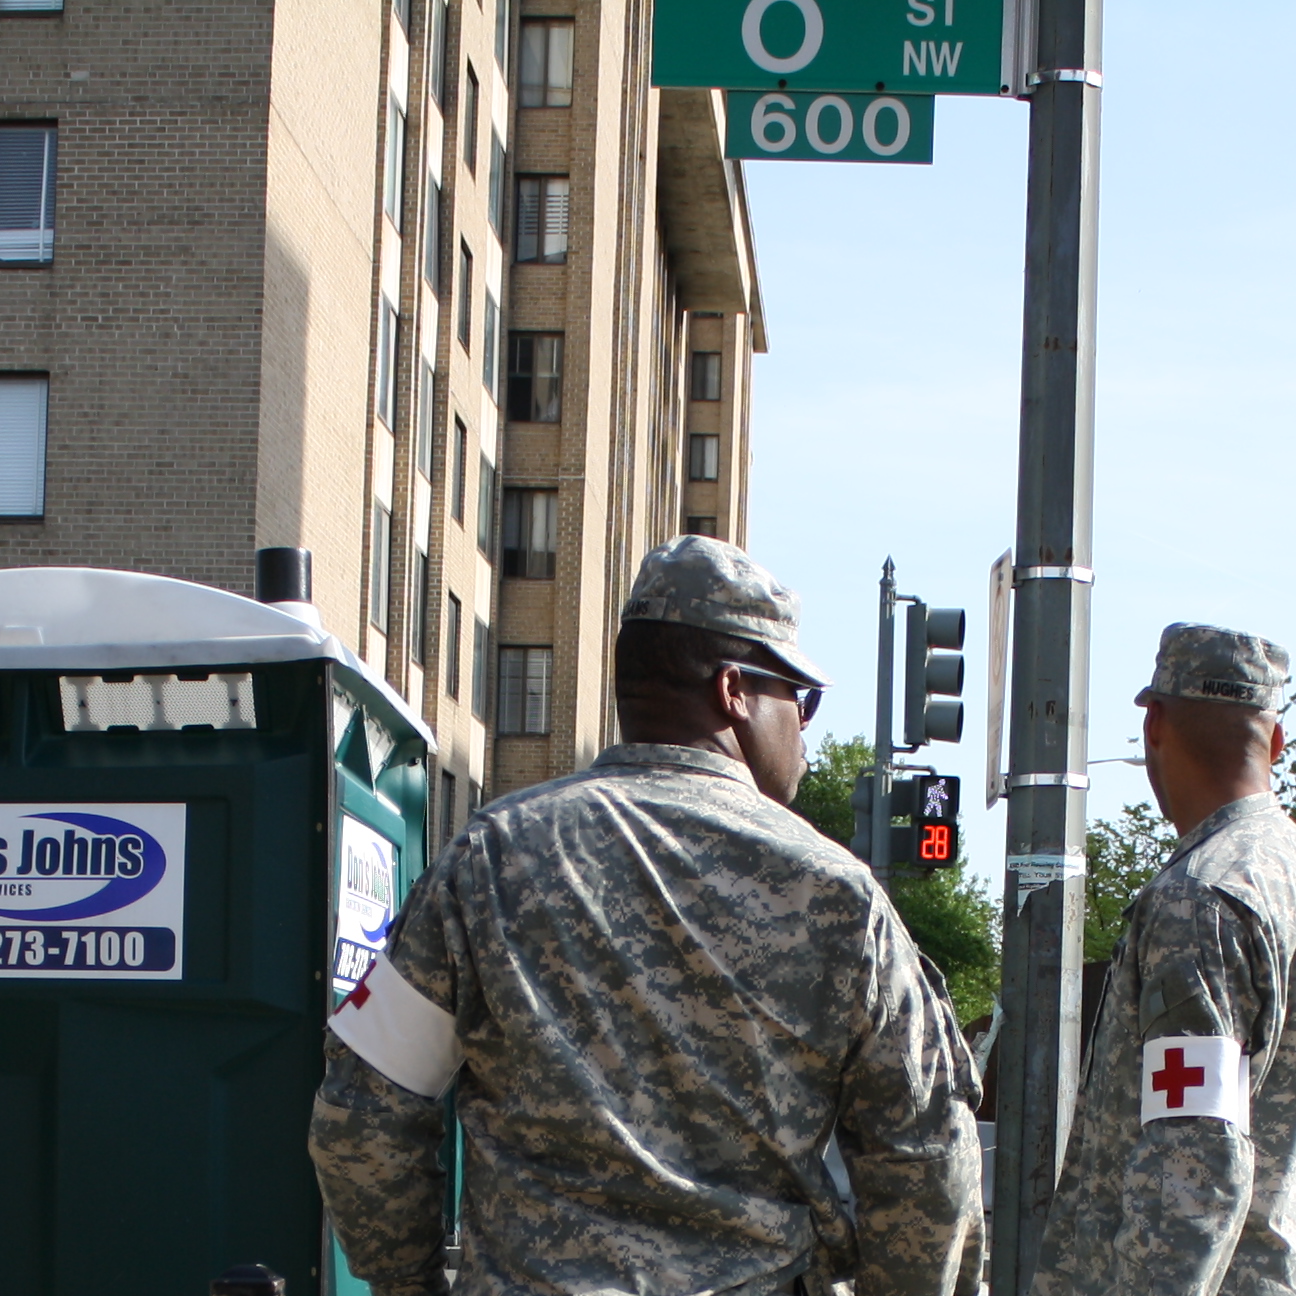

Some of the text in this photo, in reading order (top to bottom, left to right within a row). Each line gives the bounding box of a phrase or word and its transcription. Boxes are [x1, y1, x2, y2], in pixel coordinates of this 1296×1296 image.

[741, 0, 824, 74] O
[903, 40, 963, 77] NW
[750, 92, 911, 156] 600
[1202, 680, 1254, 700] HUGHES
[16, 829, 143, 877] Johns
[921, 825, 949, 859] 28
